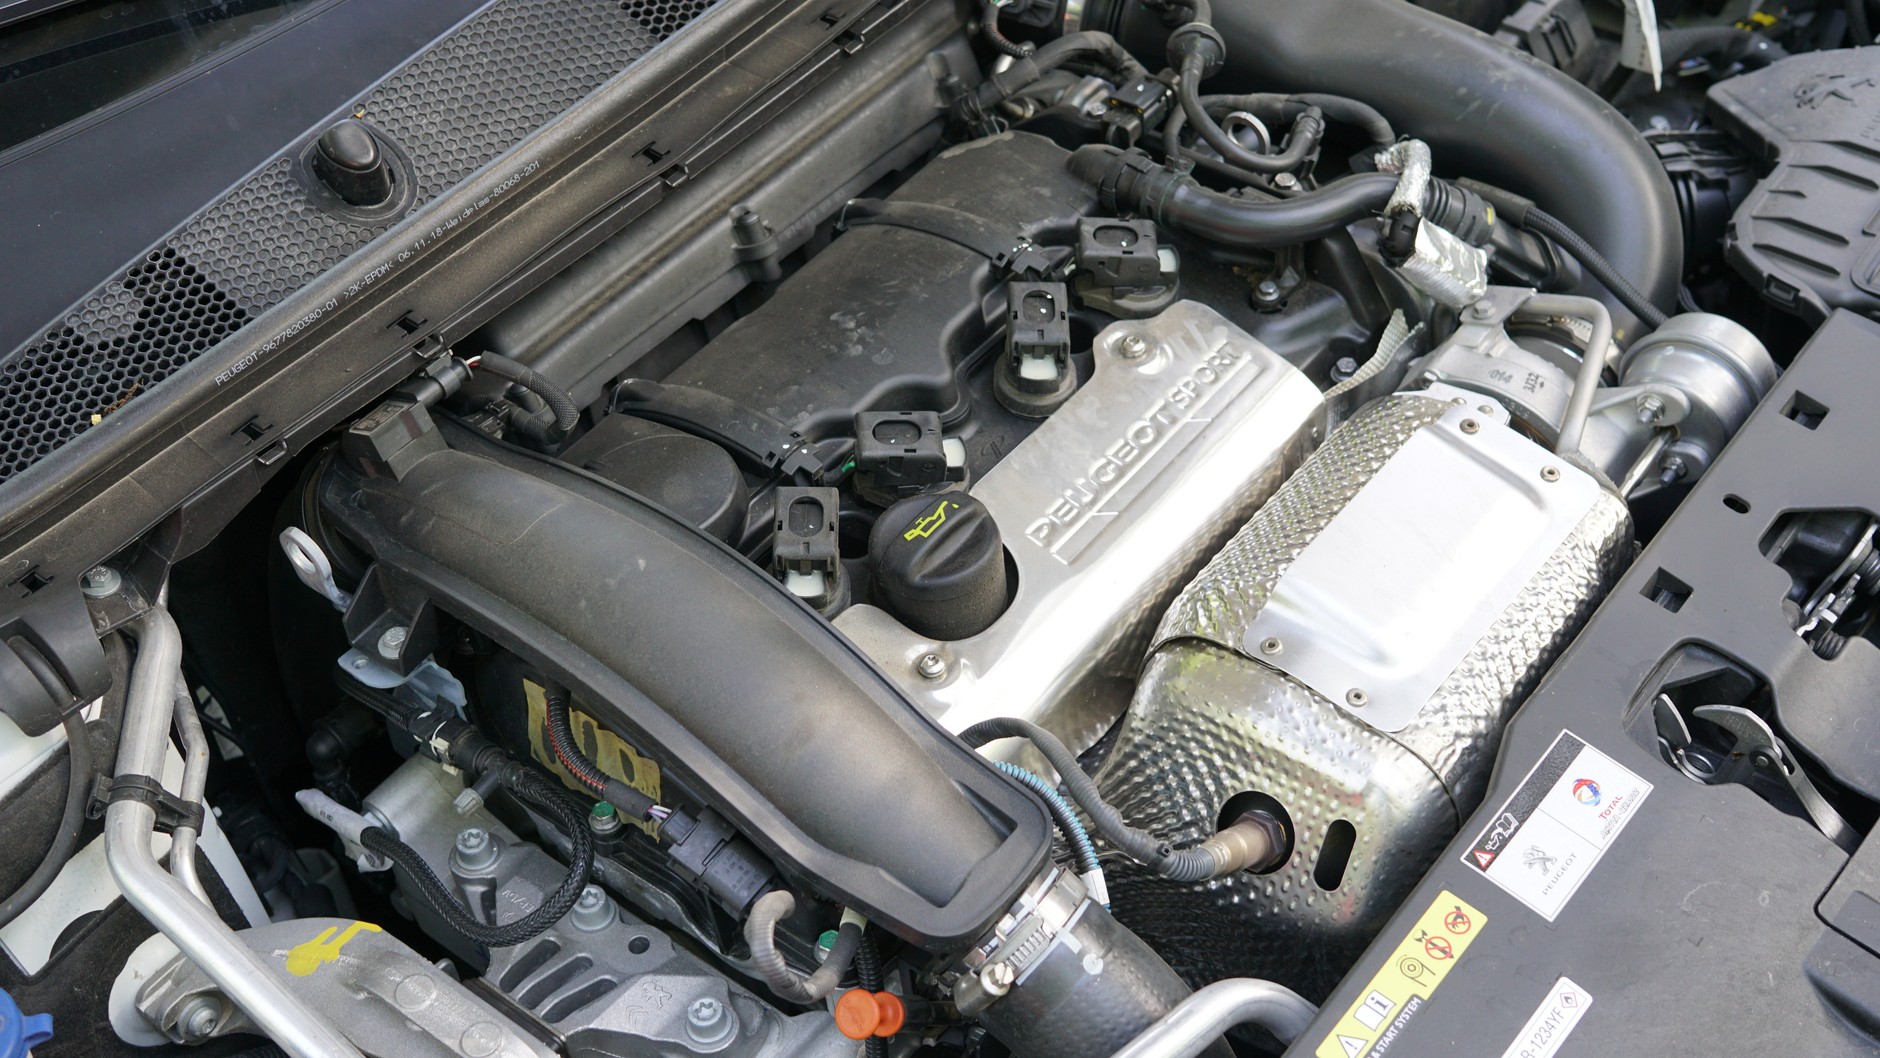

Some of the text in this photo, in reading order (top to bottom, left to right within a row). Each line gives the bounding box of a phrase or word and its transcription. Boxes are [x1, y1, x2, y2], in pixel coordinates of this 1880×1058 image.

[1025, 338, 1241, 547] PEUGEOT SPORT
[1598, 795, 1623, 820] TOTAL
[1542, 852, 1577, 895] PEUGEOT
[1376, 1025, 1399, 1053] START
[1394, 996, 1422, 1029] SYSTEM
